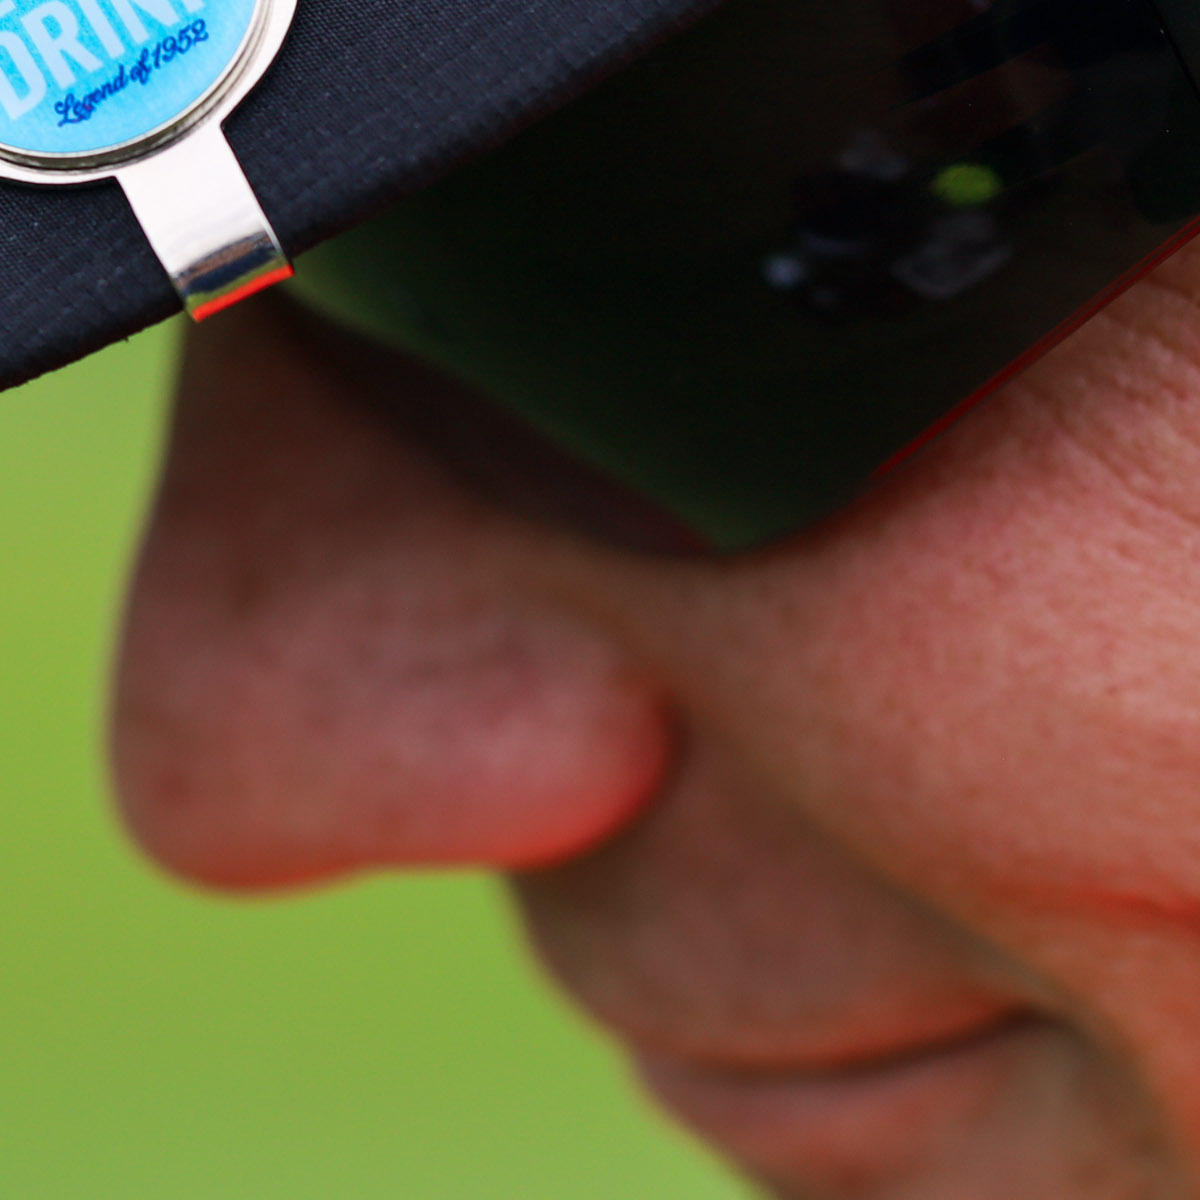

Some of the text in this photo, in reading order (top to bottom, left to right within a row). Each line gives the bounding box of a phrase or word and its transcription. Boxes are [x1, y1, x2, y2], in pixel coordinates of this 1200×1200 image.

[54, 18, 209, 127] Legend of 1952
